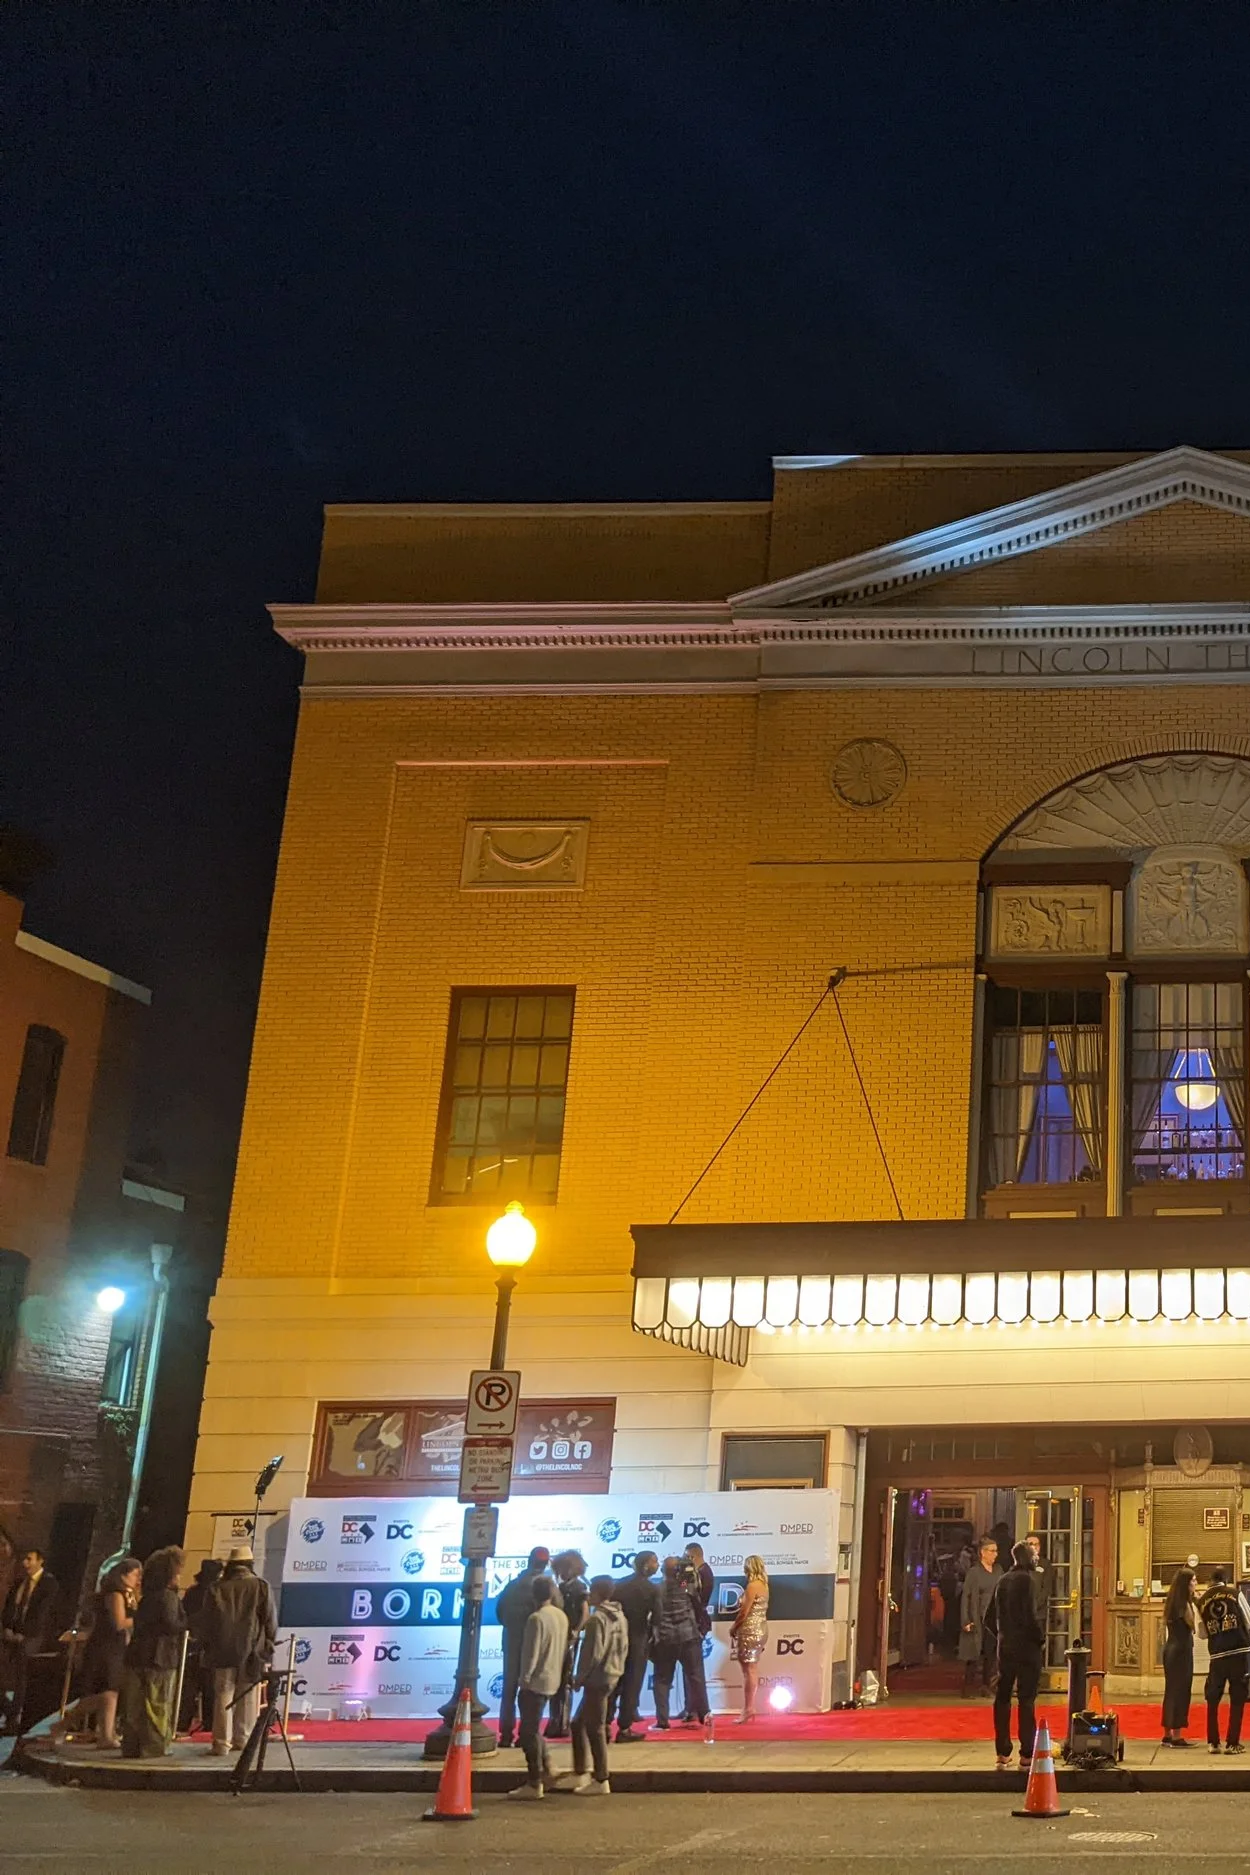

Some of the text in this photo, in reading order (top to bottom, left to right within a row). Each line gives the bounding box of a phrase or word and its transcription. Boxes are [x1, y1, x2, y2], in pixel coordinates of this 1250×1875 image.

[971, 645, 1171, 674] LINCOLN
[535, 1463, 583, 1471] @THELINCOLNDC
[342, 1523, 358, 1533] DC
[638, 1521, 655, 1532] DC
[683, 1522, 710, 1538] DC
[780, 1523, 814, 1533] DMPED
[386, 1524, 414, 1540] DC
[441, 1553, 458, 1563] DC
[611, 1552, 640, 1568] DC
[709, 1555, 743, 1564] DMPED
[293, 1560, 328, 1569] DMPED
[492, 1559, 512, 1569] THE
[329, 1642, 346, 1653] DC
[777, 1639, 805, 1655] DC
[374, 1645, 401, 1662] DC
[480, 1648, 503, 1658] MPE
[378, 1684, 412, 1694] DMPED
